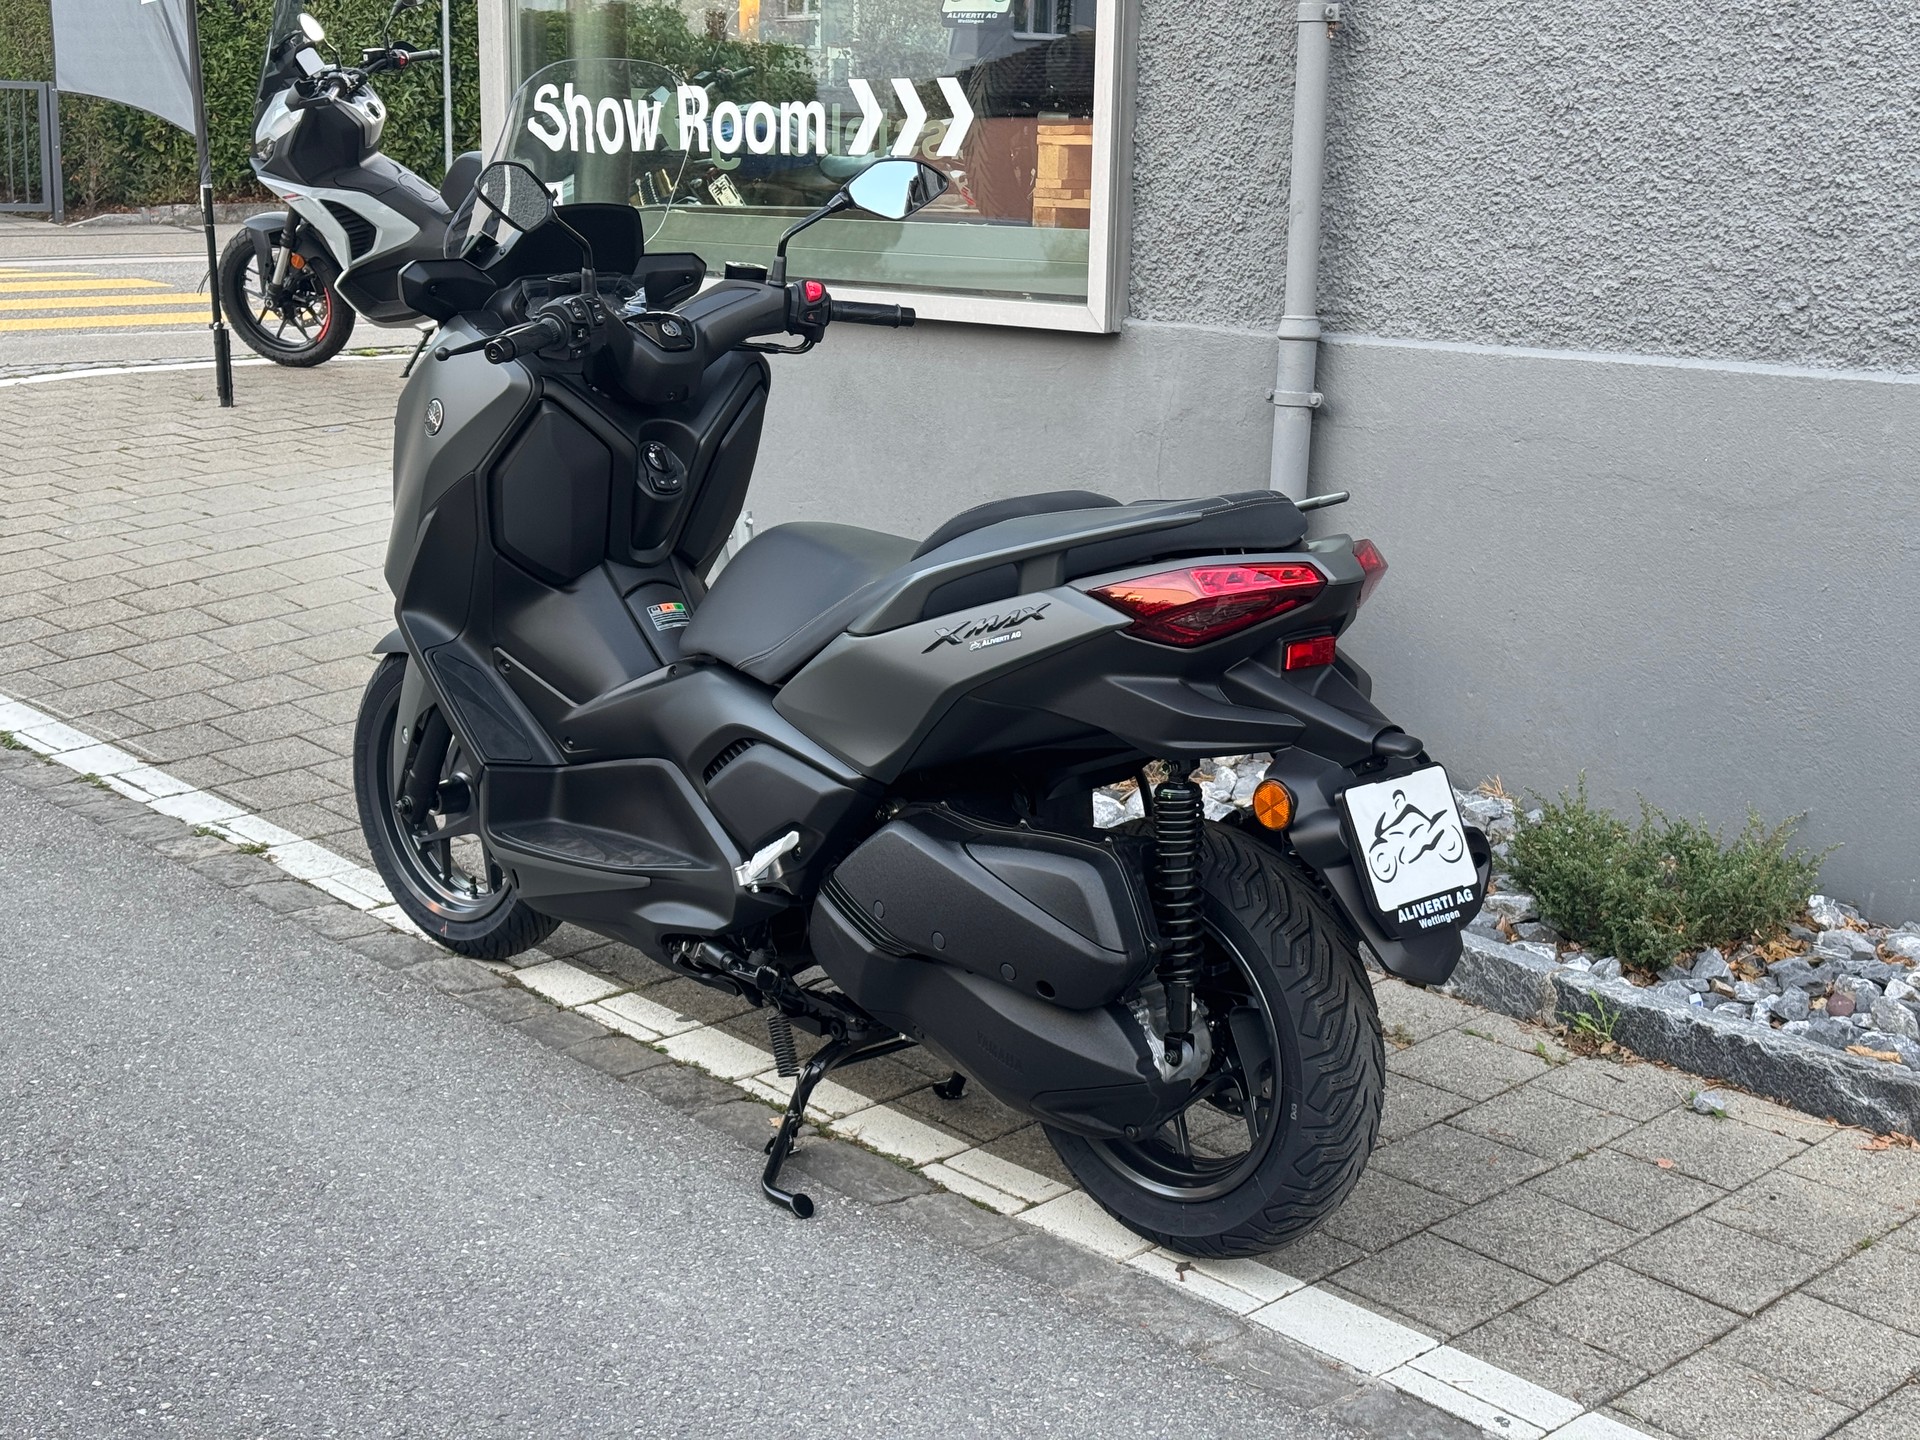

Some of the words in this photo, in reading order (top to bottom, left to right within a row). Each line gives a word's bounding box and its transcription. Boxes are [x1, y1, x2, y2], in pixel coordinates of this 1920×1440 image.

[528, 82, 659, 155] Show
[678, 84, 826, 156] Room
[981, 635, 1010, 647] ALIVERTI
[1011, 630, 1022, 639] AG
[1398, 894, 1454, 923] ALIVERTI
[1456, 888, 1474, 904] AG
[1418, 909, 1460, 929] Wettingen
